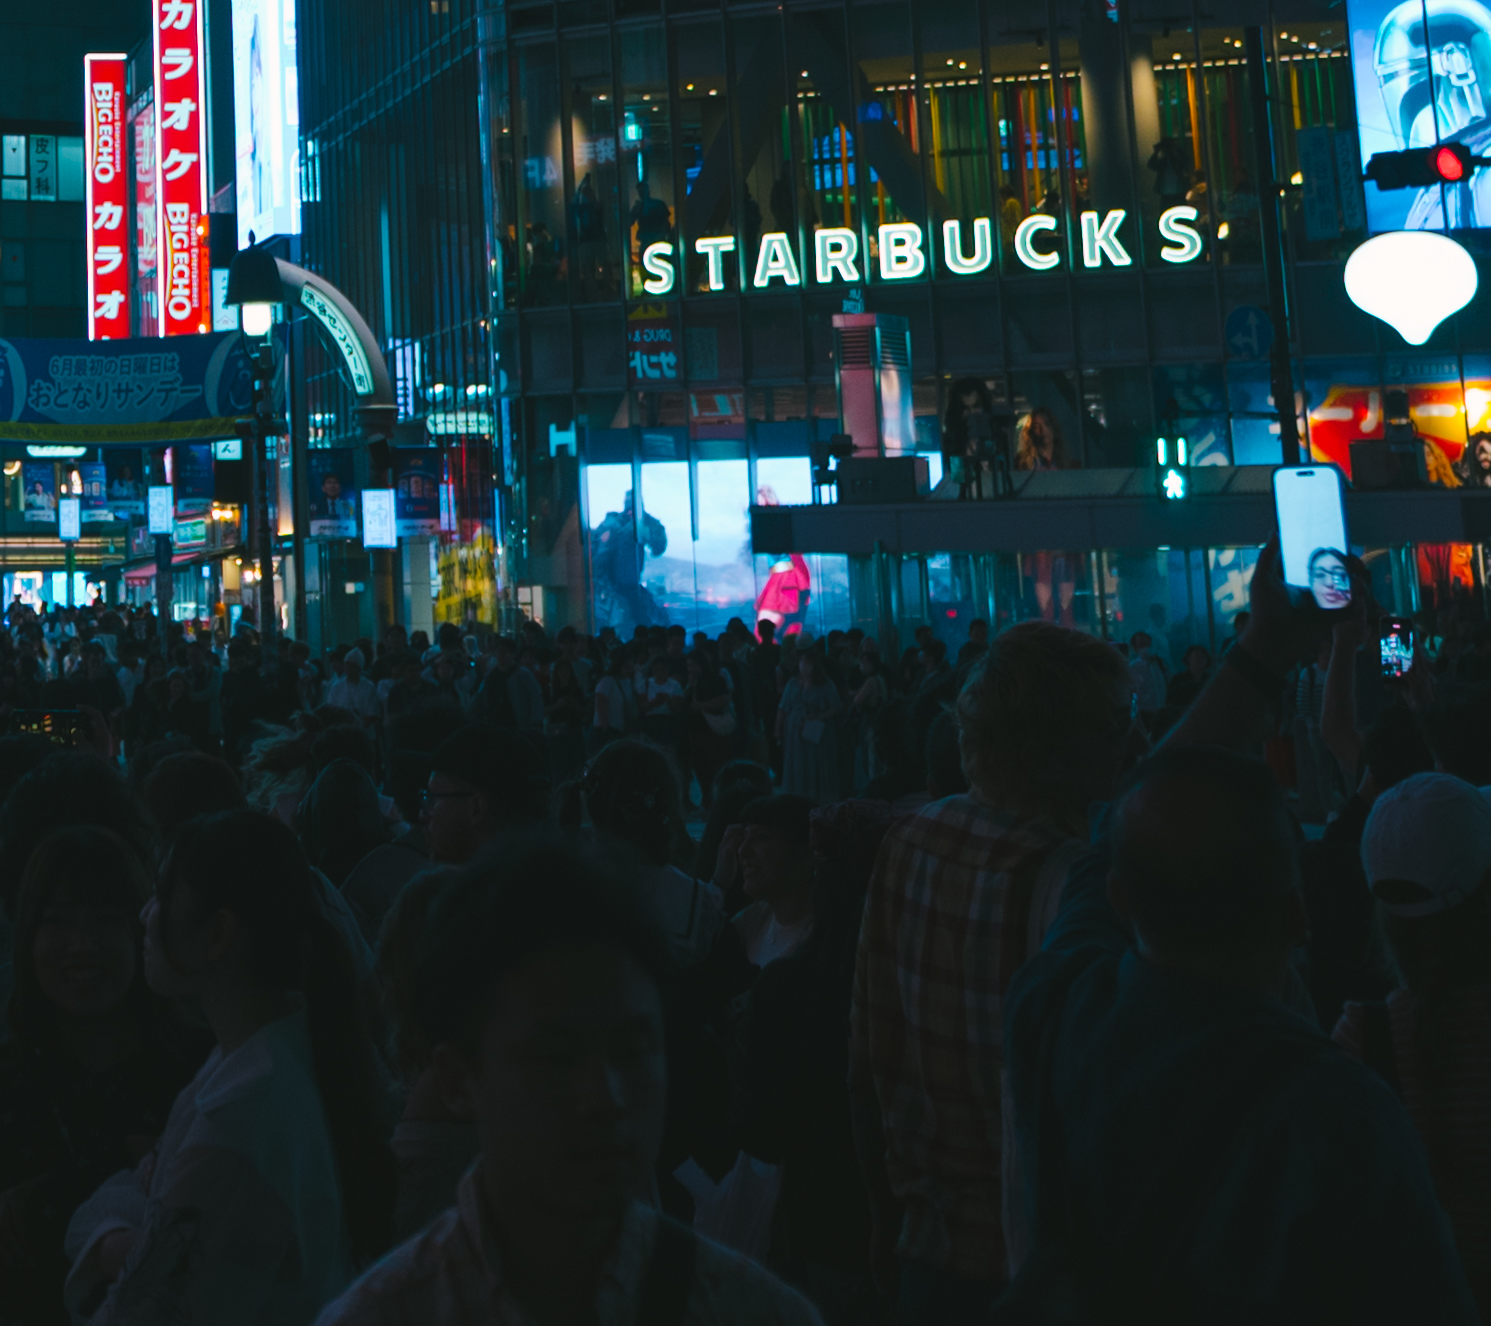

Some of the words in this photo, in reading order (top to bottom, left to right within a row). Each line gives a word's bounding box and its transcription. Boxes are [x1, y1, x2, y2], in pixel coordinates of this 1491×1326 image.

[93, 201, 126, 340] カラオ
[642, 204, 1204, 296] STARBUCKS
[29, 378, 203, 409] おとなりサンデー
[49, 354, 180, 378] 6月最初の日曜日は
